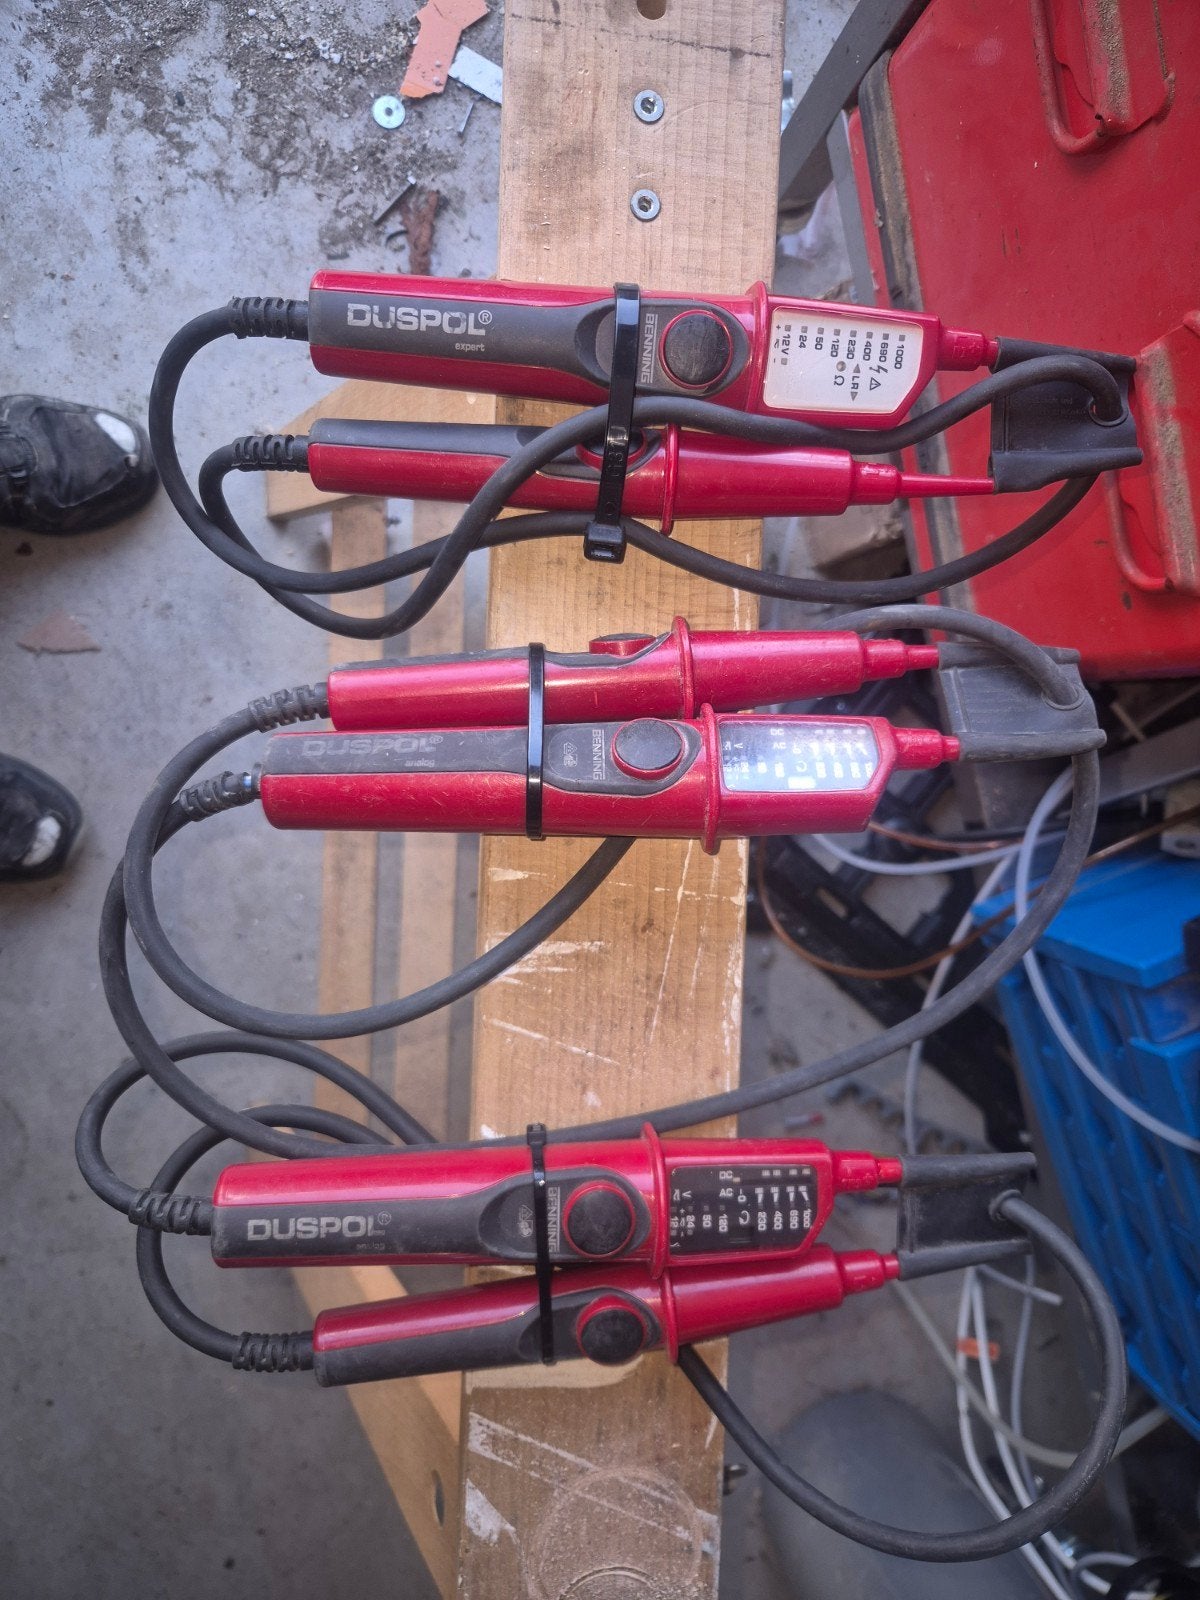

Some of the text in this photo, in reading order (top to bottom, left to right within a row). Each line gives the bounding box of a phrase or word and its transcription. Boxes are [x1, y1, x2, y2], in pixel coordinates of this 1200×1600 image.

[455, 341, 485, 352] expert
[641, 313, 655, 384] BENNING
[798, 335, 808, 349] 24
[814, 337, 824, 351] 50
[830, 338, 840, 358] 120
[846, 339, 857, 360] 230
[862, 340, 872, 361] 400
[878, 342, 889, 363] 690
[894, 344, 905, 370] 1000
[404, 758, 435, 768] analog
[592, 729, 603, 780] BENNING
[719, 1170, 733, 1180] DC
[719, 1187, 734, 1198] AC
[686, 1214, 696, 1228] 24
[702, 1214, 713, 1228] 50
[718, 1213, 729, 1232] 120
[757, 1211, 767, 1231] 230
[773, 1210, 783, 1230] 400
[803, 1208, 812, 1229] 1000
